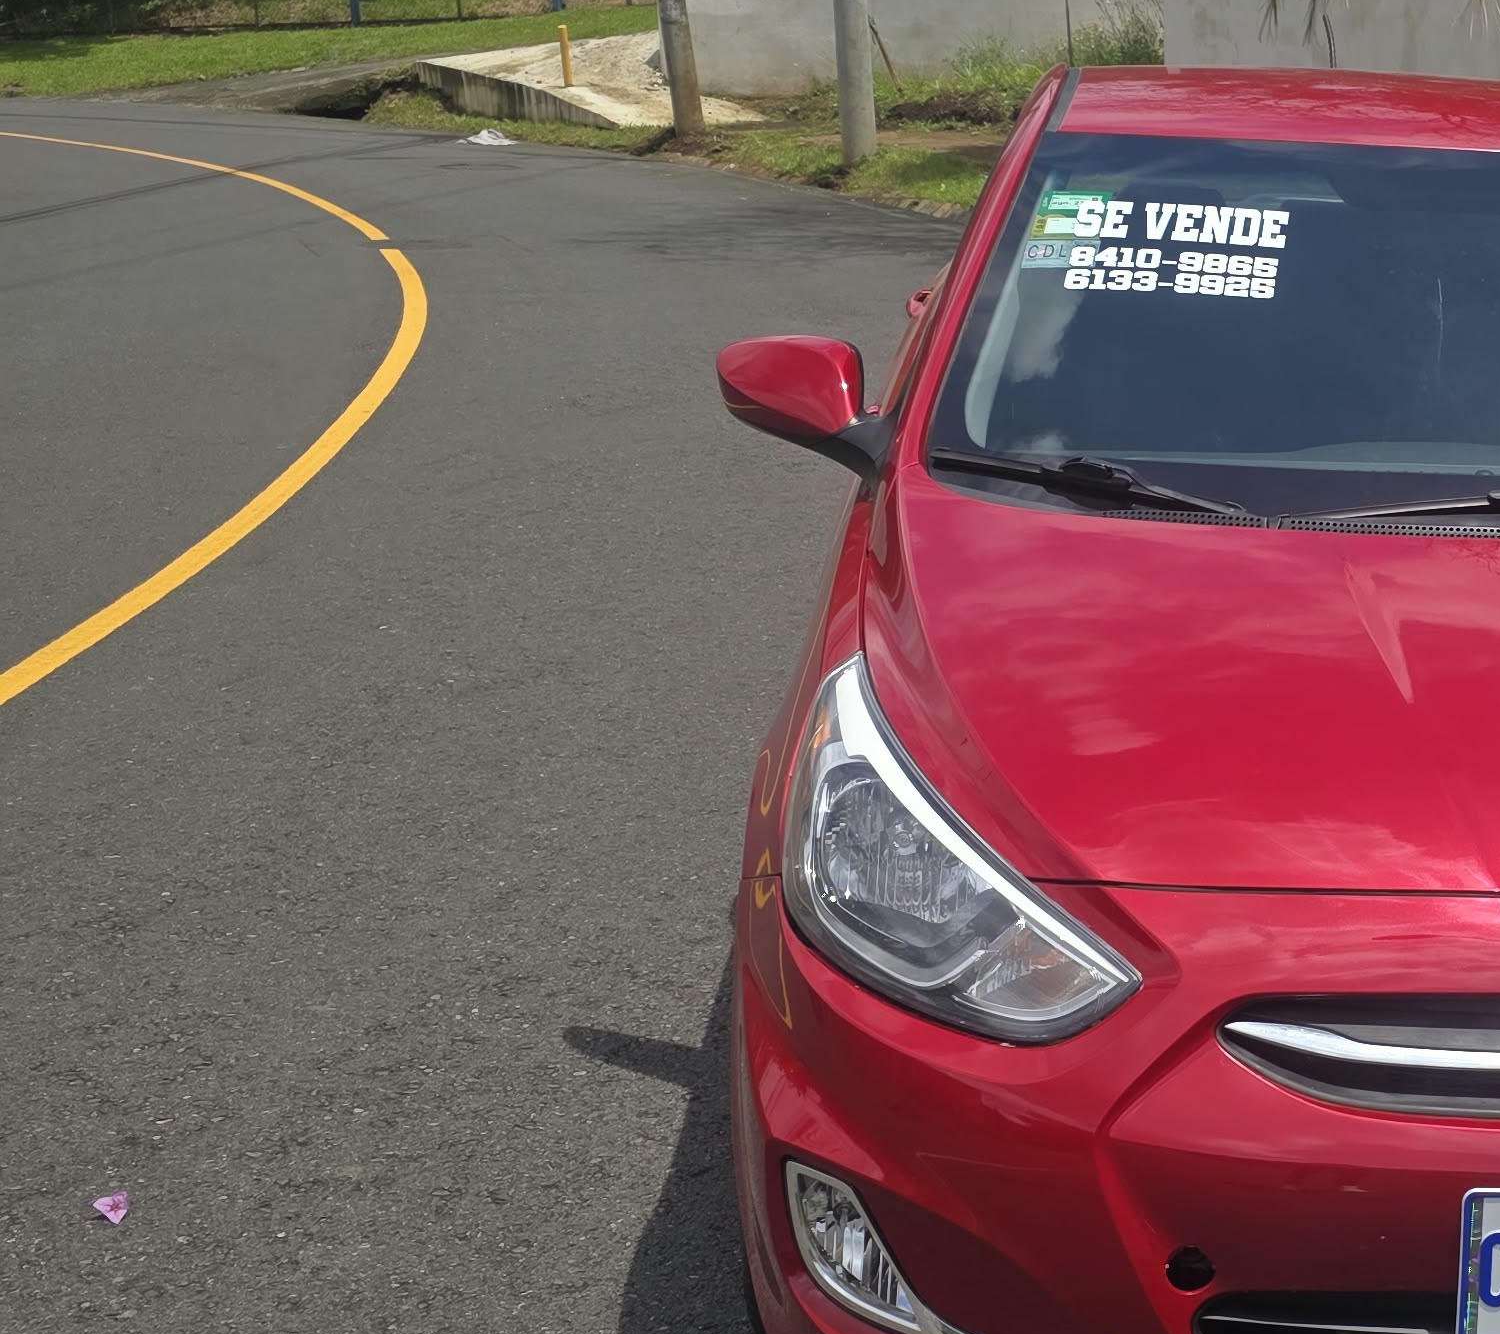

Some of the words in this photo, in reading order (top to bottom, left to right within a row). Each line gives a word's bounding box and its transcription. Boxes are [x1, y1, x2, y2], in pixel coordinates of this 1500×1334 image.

[1073, 201, 1133, 238] SE
[1145, 202, 1290, 248] VENDE
[1068, 247, 1279, 277] 8410-9865
[1063, 269, 1276, 299] 6133-9925
